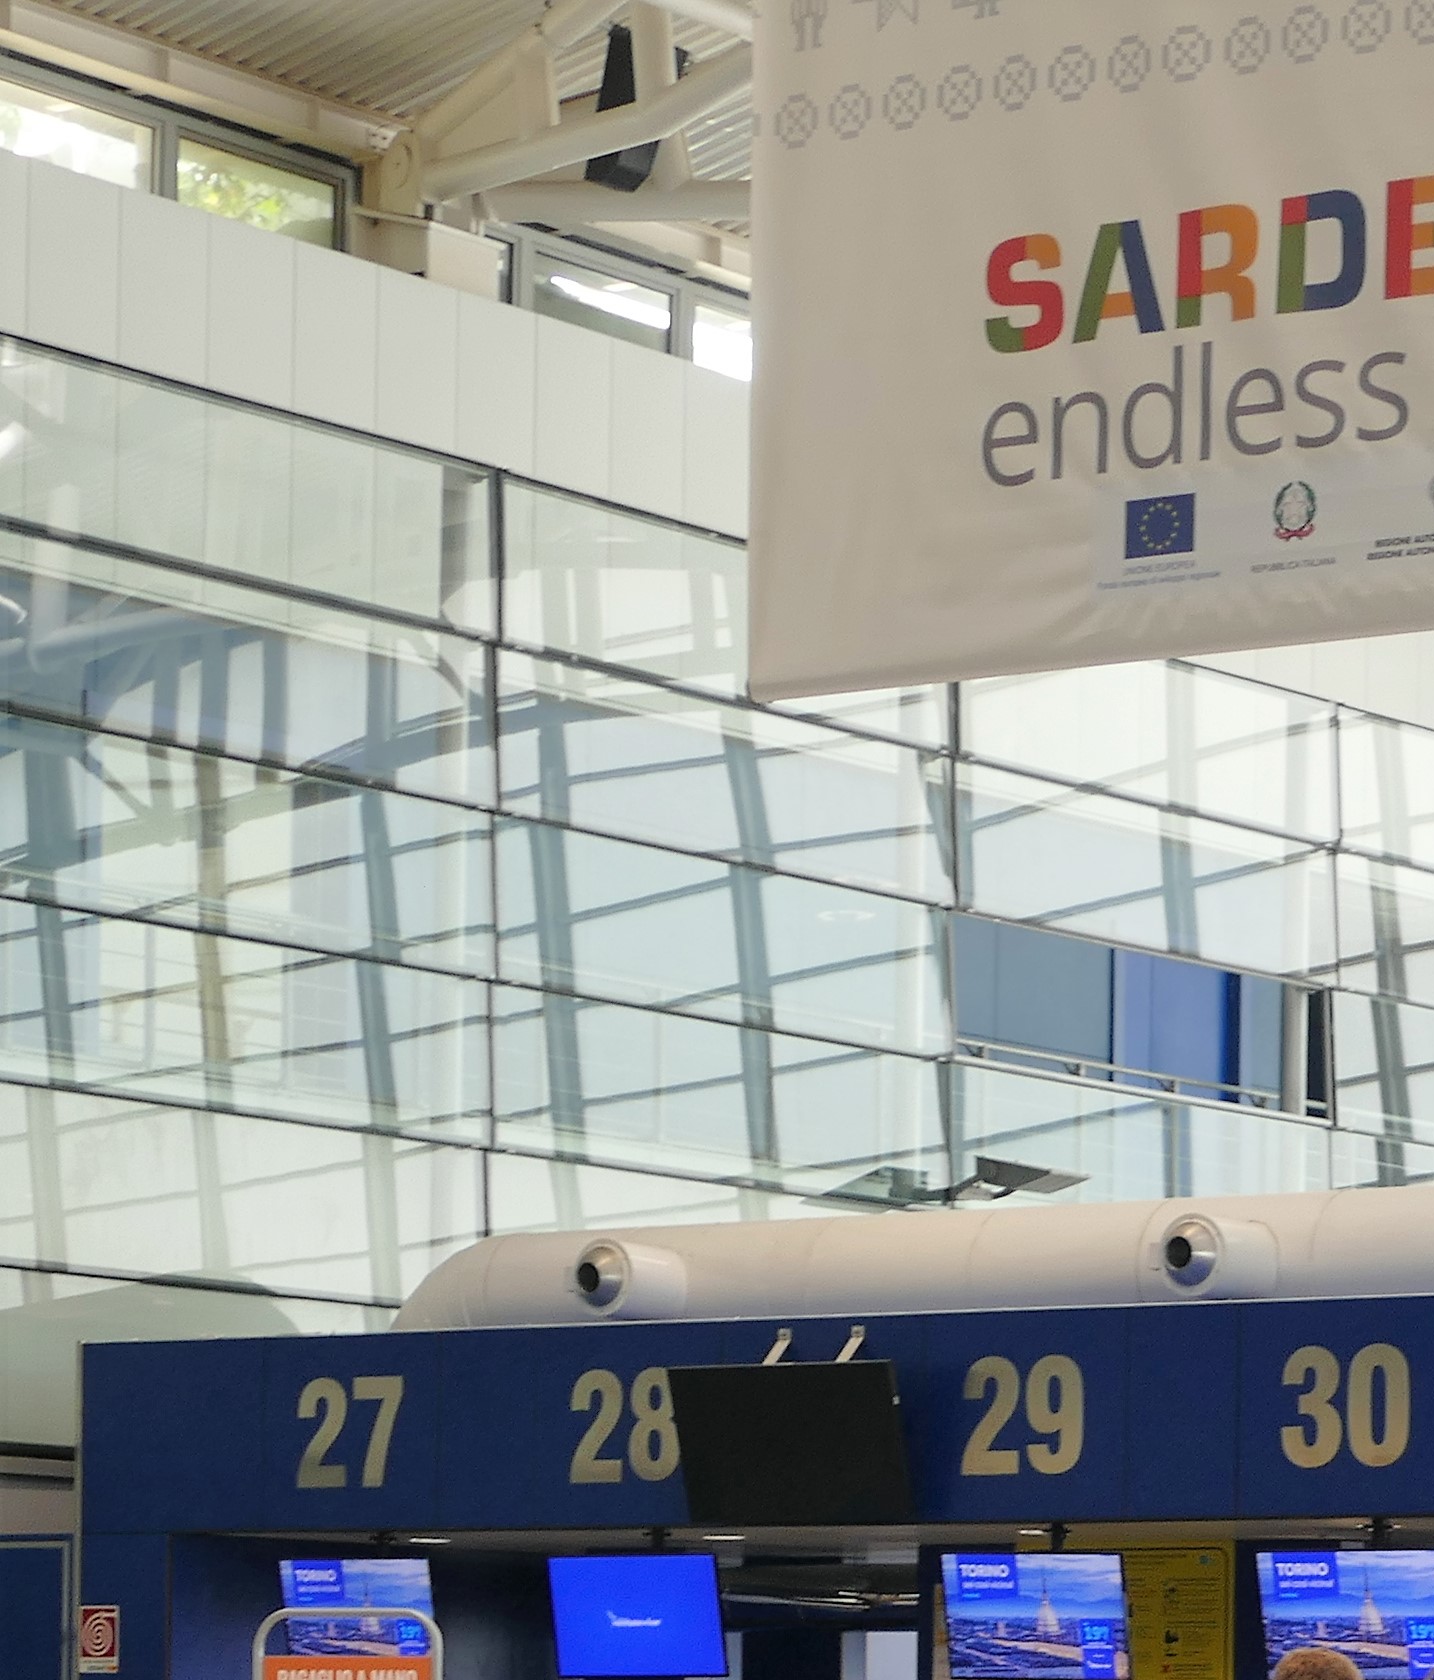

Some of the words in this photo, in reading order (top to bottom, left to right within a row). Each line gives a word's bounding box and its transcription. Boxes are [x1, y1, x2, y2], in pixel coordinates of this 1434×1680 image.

[981, 343, 1409, 488] endless
[296, 1375, 405, 1489] 27
[569, 1368, 681, 1483] 28
[960, 1354, 1084, 1476] 29
[1280, 1343, 1410, 1469] 30
[959, 1564, 1010, 1578] TORINO
[1275, 1562, 1330, 1576] TORINO
